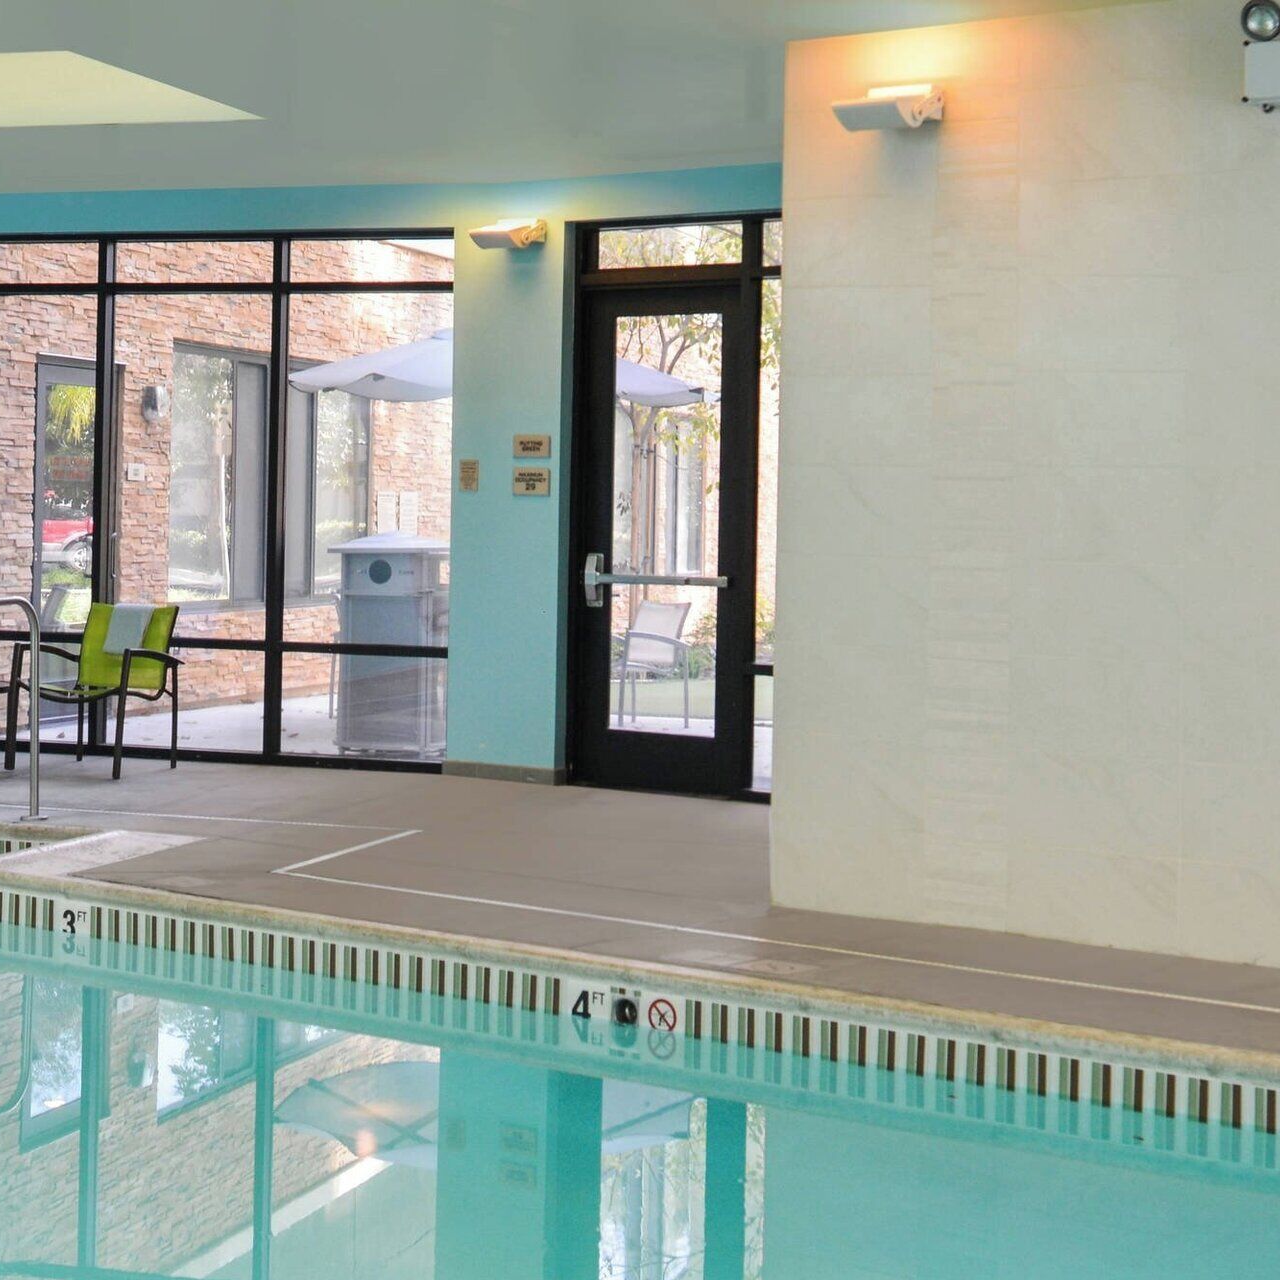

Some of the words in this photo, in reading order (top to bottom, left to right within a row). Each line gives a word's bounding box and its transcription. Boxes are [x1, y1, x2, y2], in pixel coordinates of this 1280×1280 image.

[62, 909, 76, 934] 3
[77, 911, 87, 922] FT
[572, 990, 591, 1018] 4
[592, 992, 605, 1005] FT
